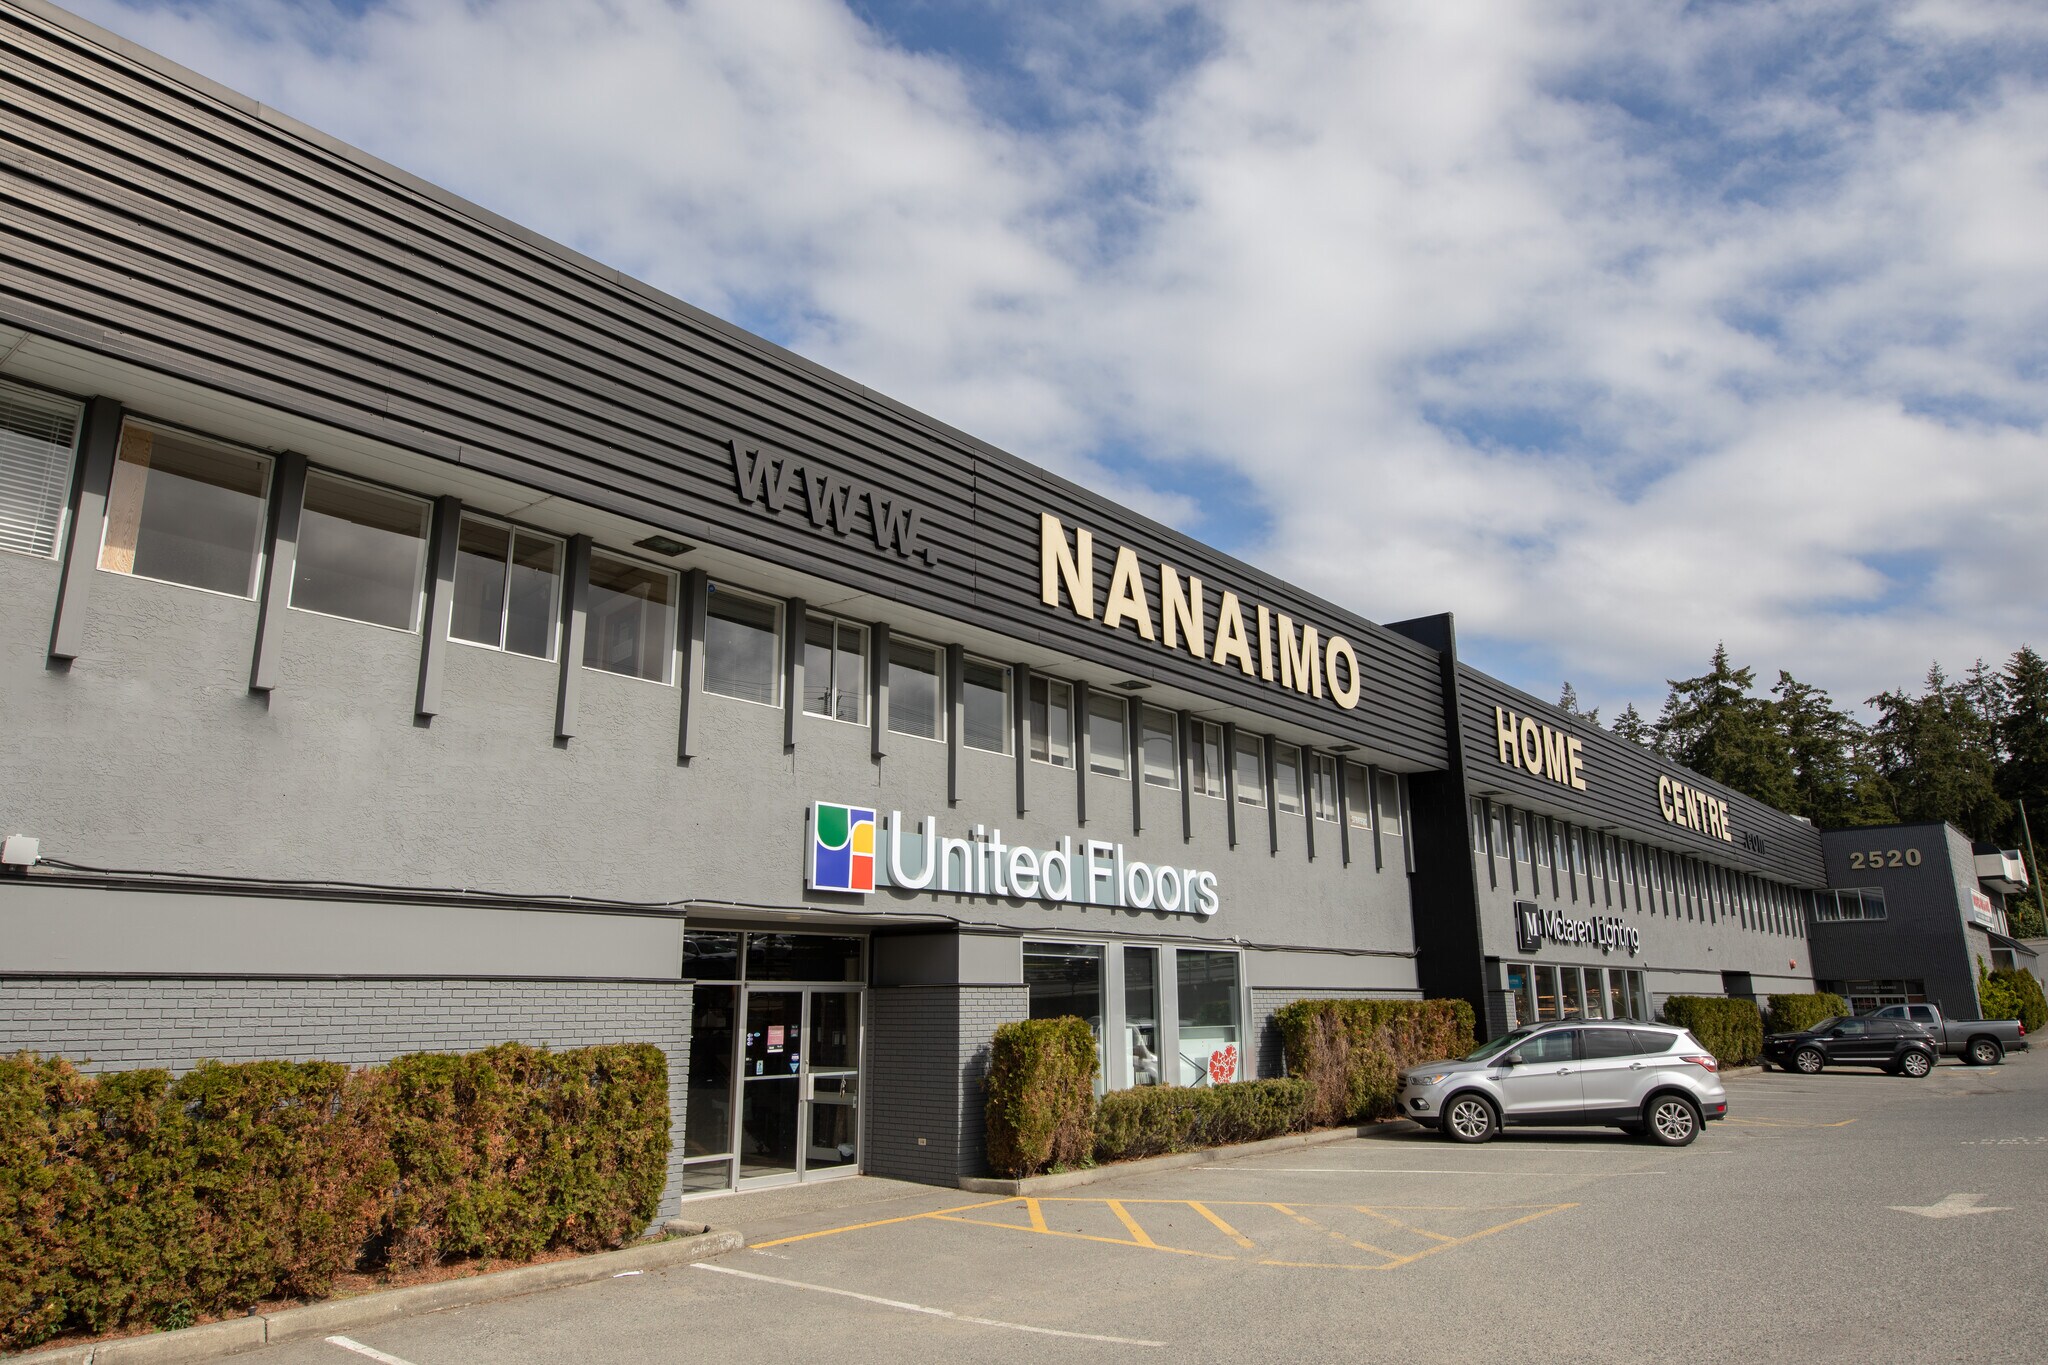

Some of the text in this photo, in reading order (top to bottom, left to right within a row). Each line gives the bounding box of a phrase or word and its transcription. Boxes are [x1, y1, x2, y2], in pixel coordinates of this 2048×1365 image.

[1040, 512, 1361, 710] NANAIMO
[1495, 706, 1586, 791] HOME
[1658, 775, 1732, 842] CENTRE
[887, 810, 1219, 916] United Floors
[1850, 848, 1922, 869] 2520
[1597, 916, 1640, 954] Lighting
